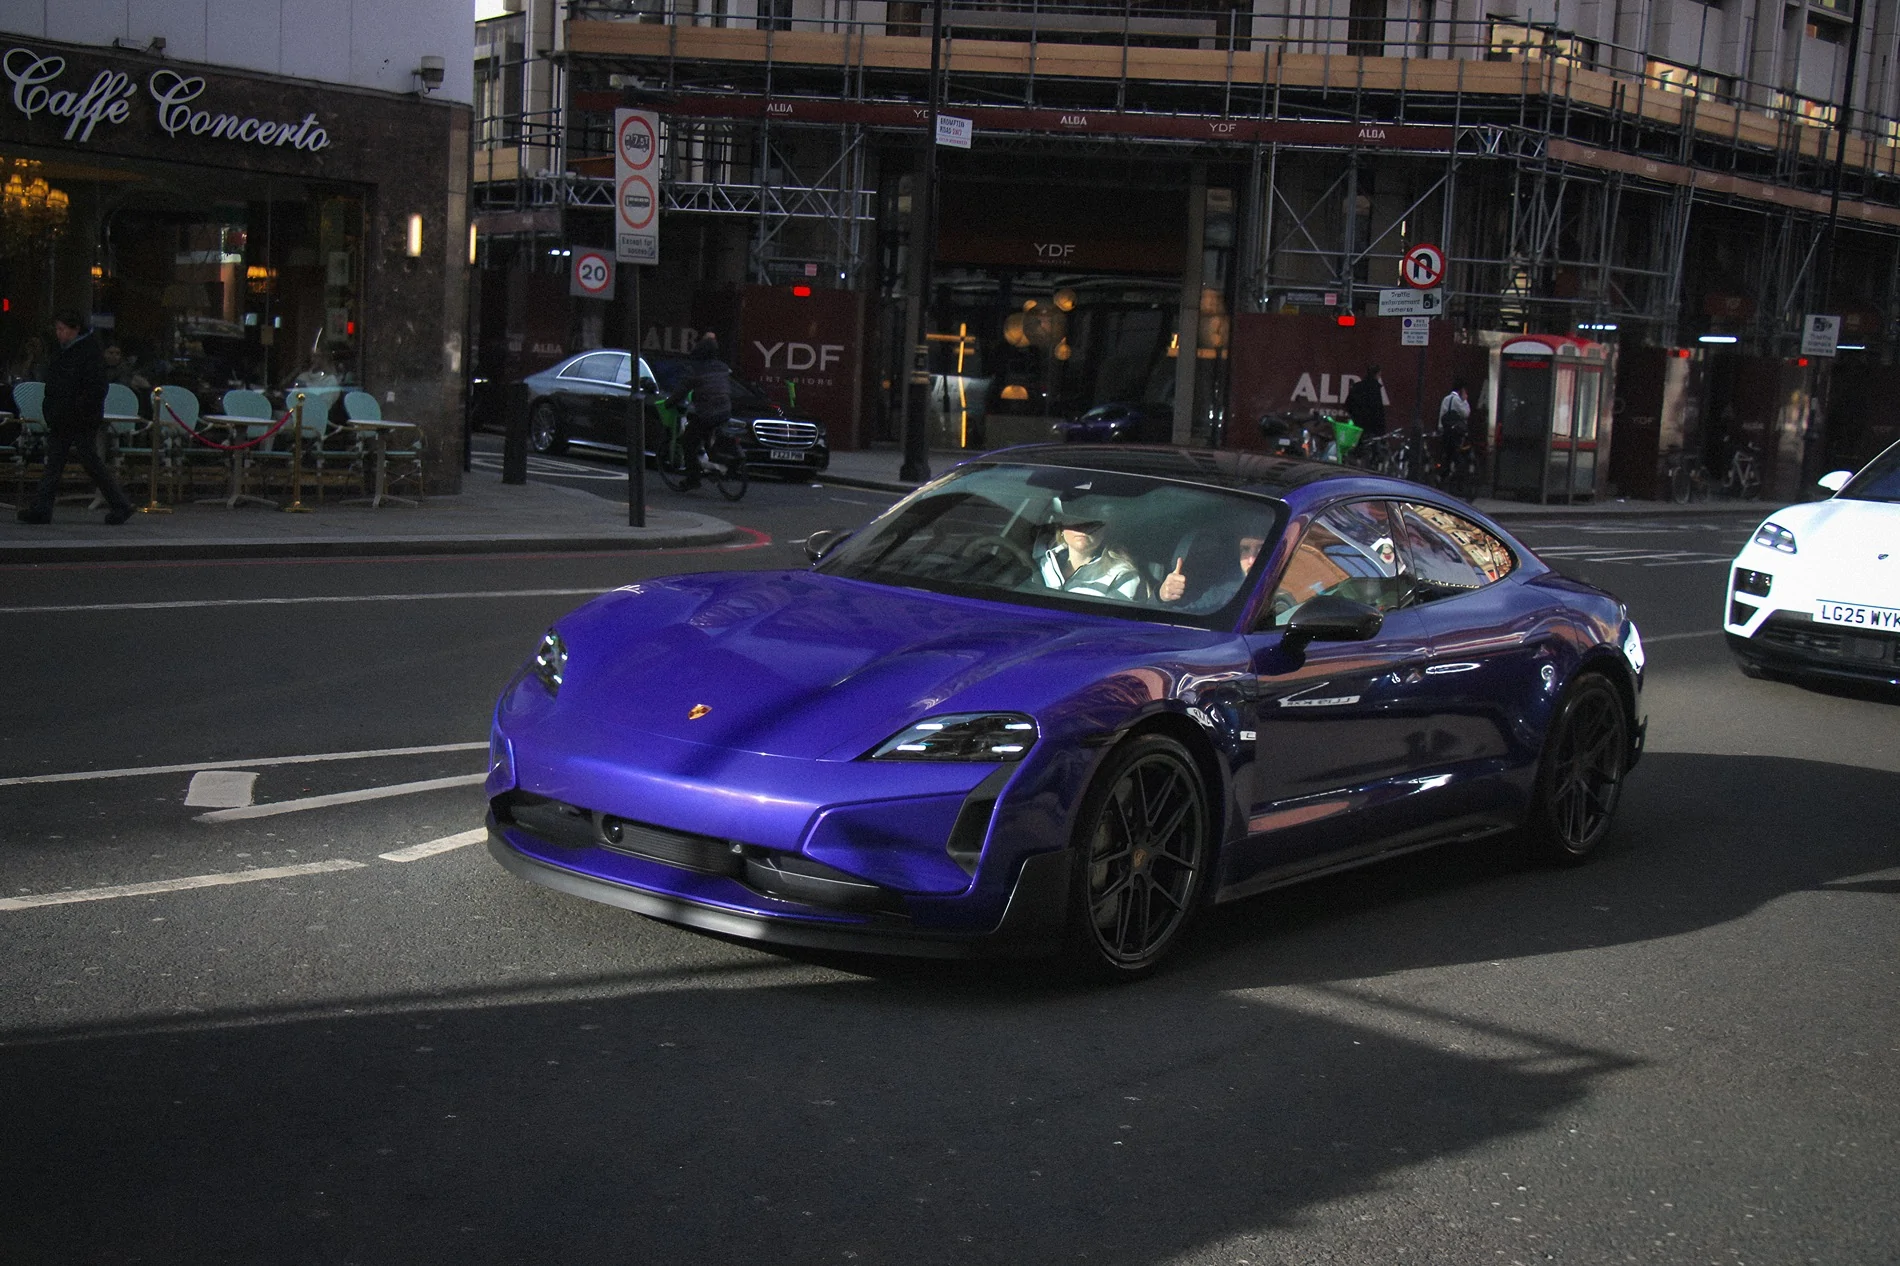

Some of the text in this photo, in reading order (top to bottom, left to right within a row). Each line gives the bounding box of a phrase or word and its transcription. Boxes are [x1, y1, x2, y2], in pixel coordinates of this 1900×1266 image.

[150, 69, 330, 151] Concerto
[766, 103, 793, 113] ALBA
[1060, 115, 1087, 125] ALBA
[1209, 123, 1236, 133] YDF
[1358, 129, 1386, 139] ALBA
[622, 237, 642, 248] Except
[1033, 242, 1076, 257] YDF
[582, 264, 606, 282] 20
[642, 326, 698, 355] ALB
[753, 340, 845, 371] YDF
[760, 376, 833, 386] INTRIORS
[1822, 605, 1900, 627] LG25 WYK
